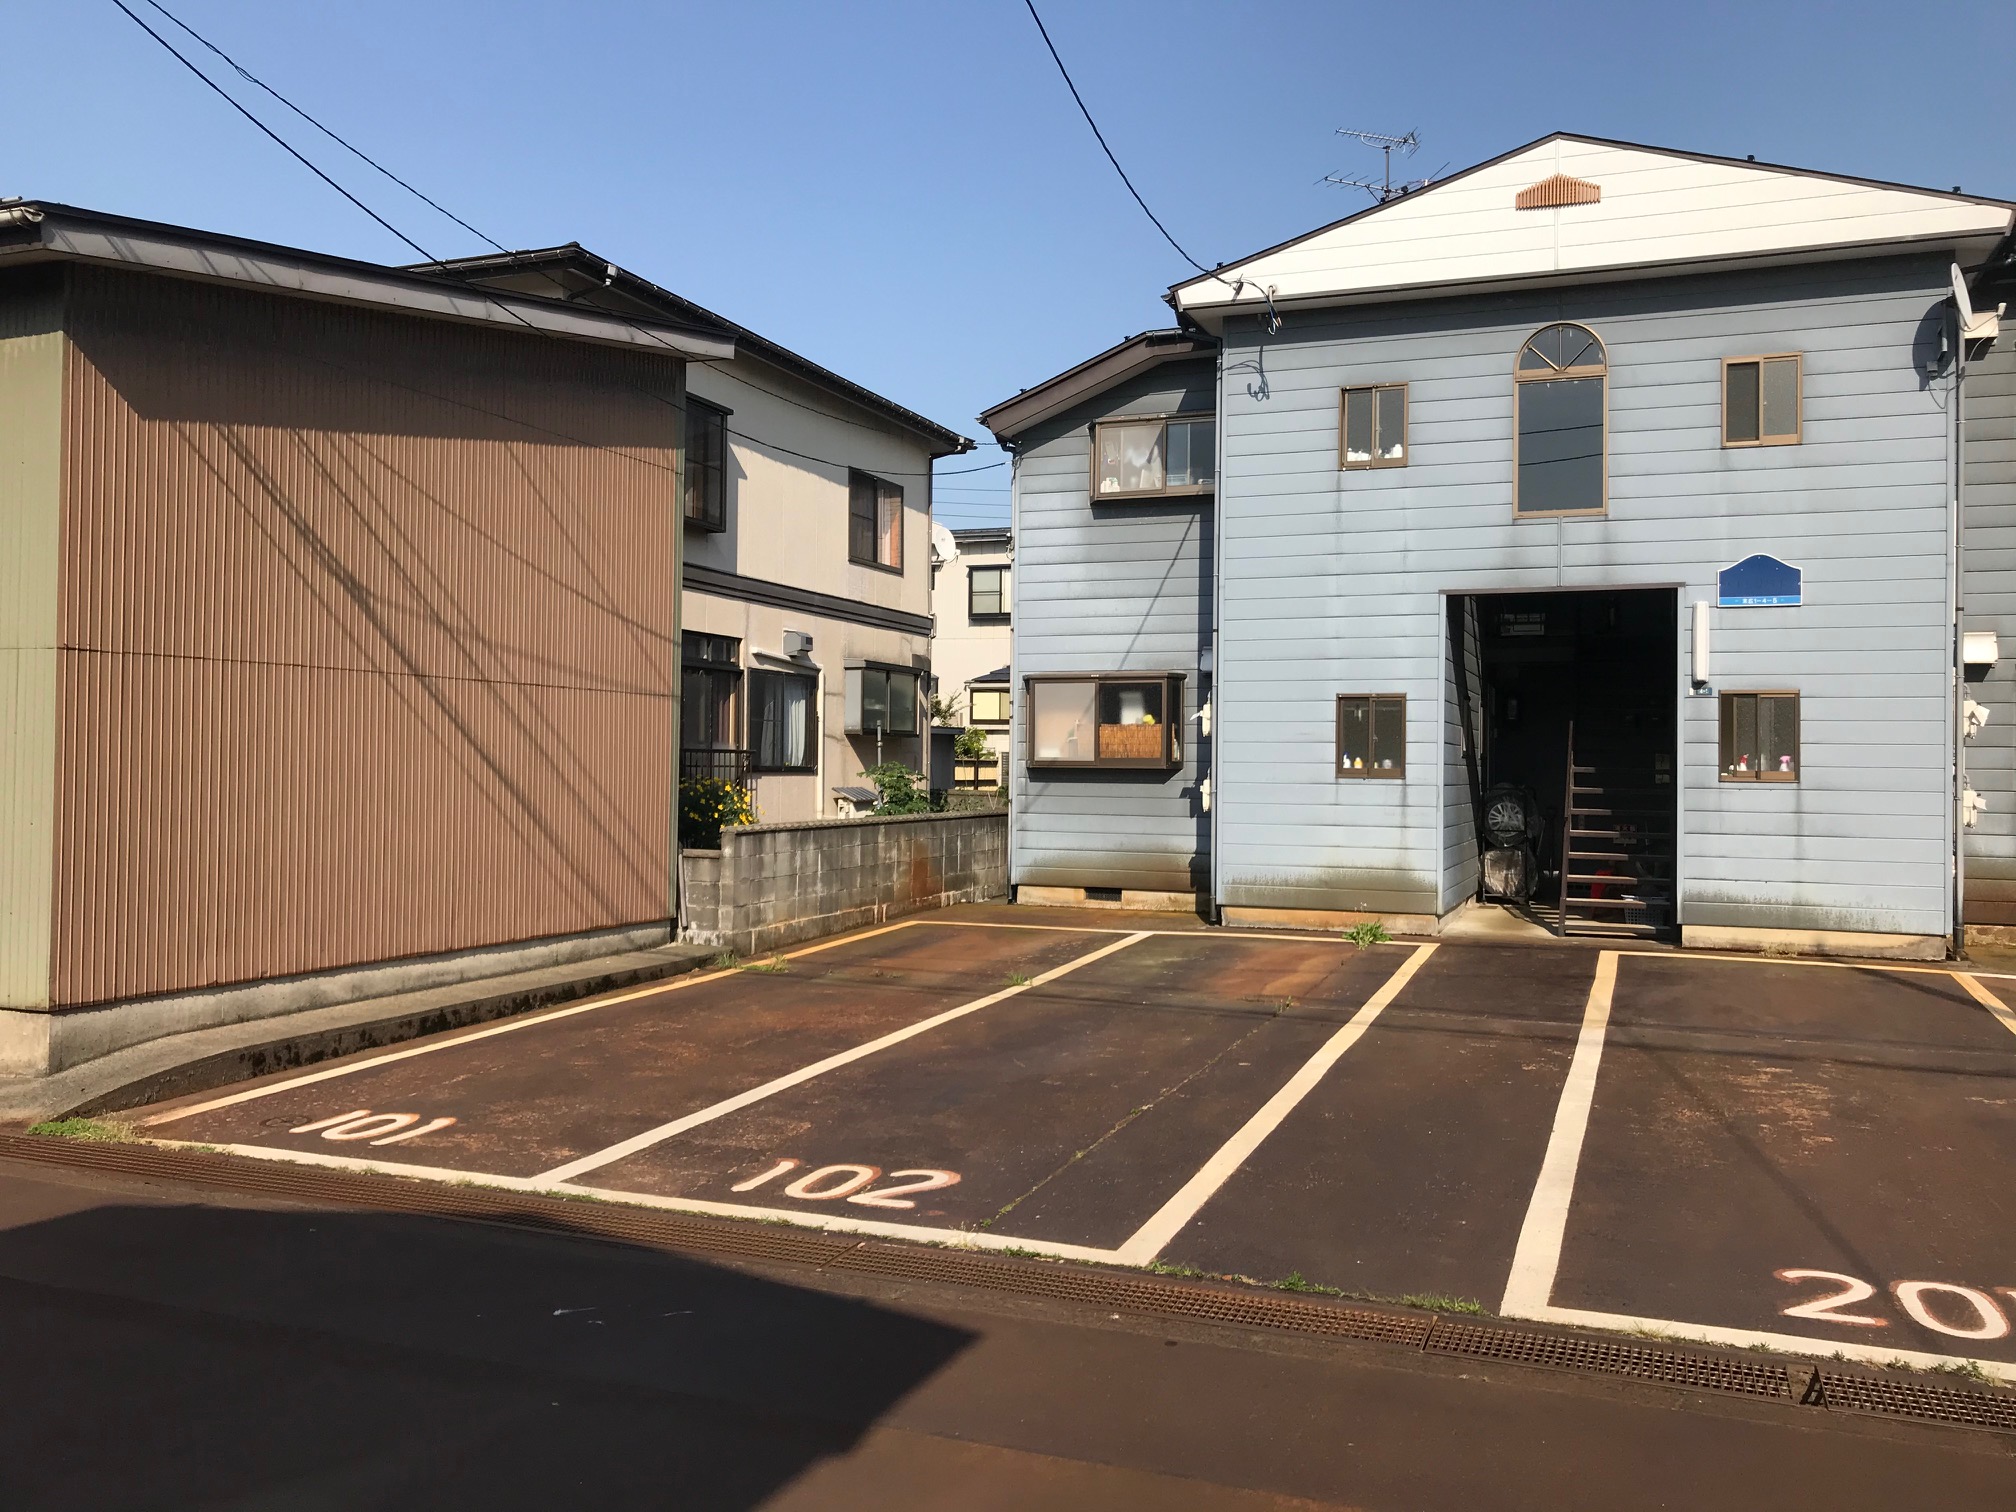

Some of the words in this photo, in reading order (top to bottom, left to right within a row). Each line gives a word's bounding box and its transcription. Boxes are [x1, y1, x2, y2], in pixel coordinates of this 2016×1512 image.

[289, 1109, 458, 1146] 101
[730, 1158, 961, 1209] 102
[1773, 1268, 2016, 1340] 20
